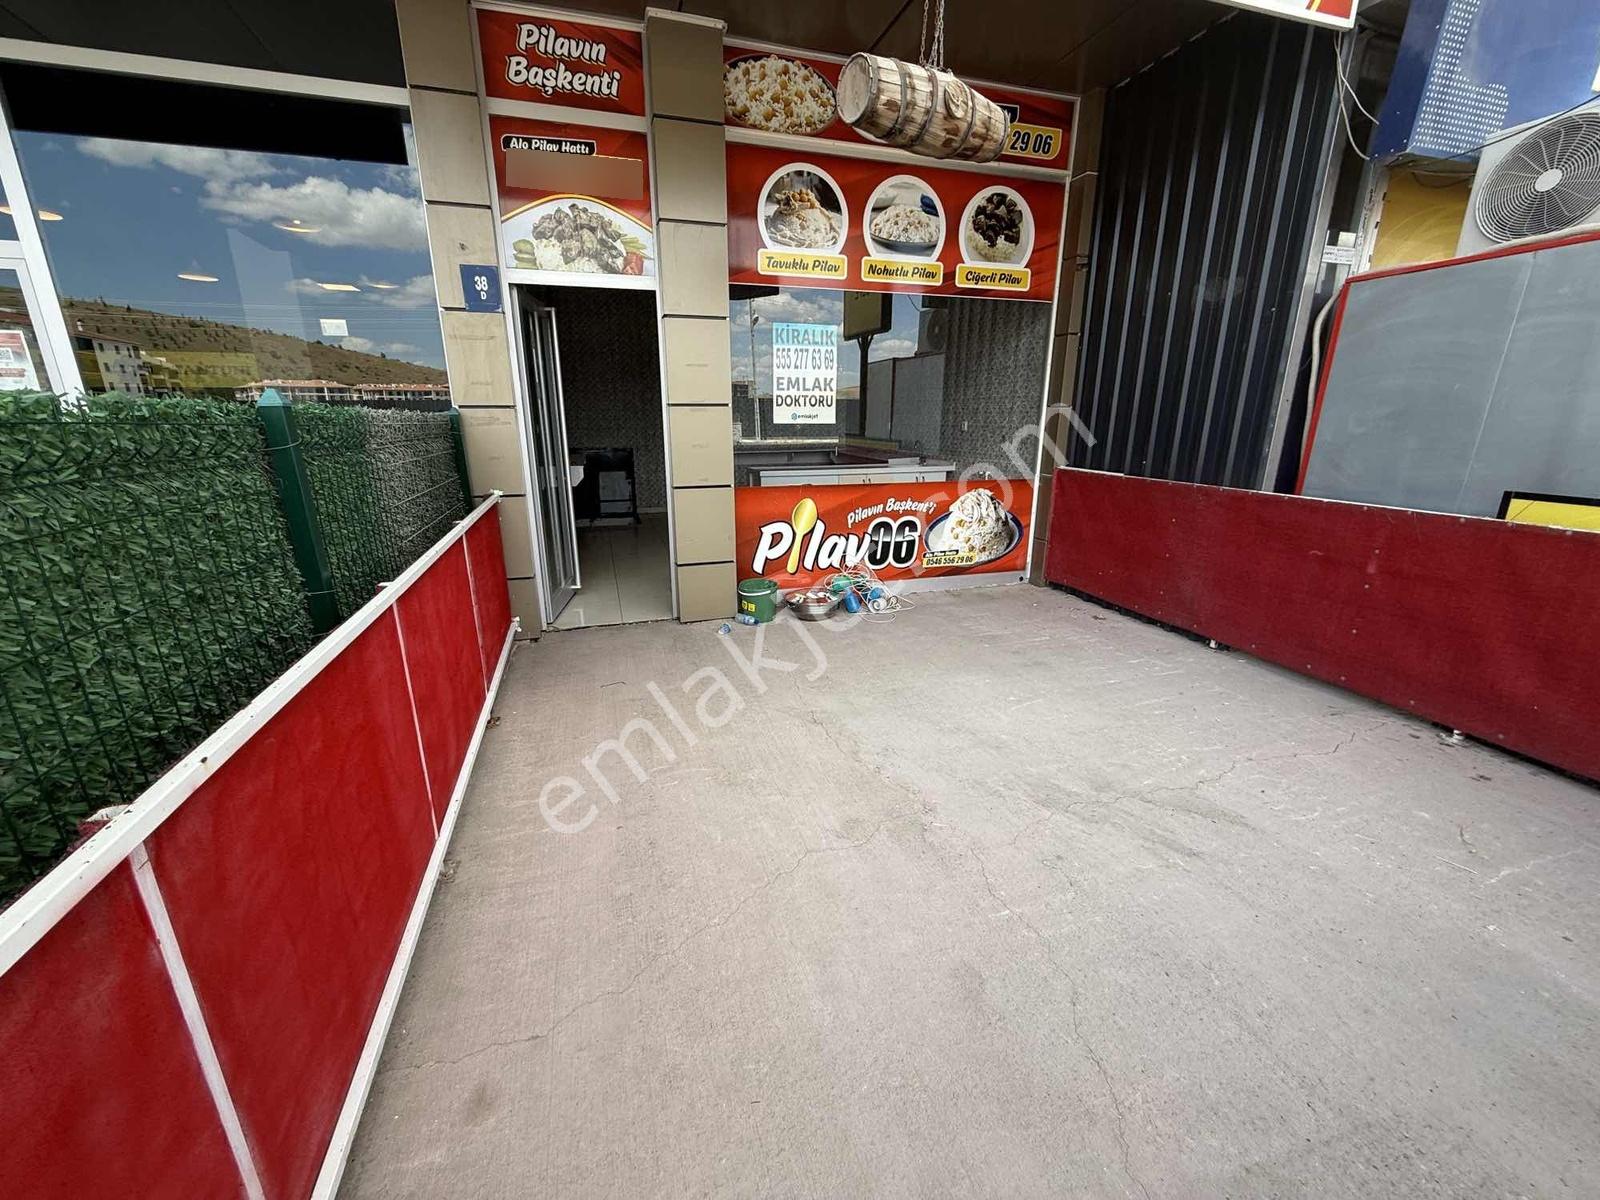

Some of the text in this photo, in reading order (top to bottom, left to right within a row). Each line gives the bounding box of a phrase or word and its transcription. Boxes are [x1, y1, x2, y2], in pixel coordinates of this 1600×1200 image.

[517, 23, 606, 65] Pilavın
[505, 55, 621, 99] Başkenti
[509, 137, 589, 154] Alo Pilav Hattı
[1010, 130, 1053, 155] 29 06
[765, 256, 841, 274] Tavuklu Pilav
[867, 263, 938, 280] Nohutlu Pilav
[474, 275, 488, 291] 38
[965, 270, 1023, 285] Ciğerli Pilav
[480, 290, 487, 300] D
[775, 324, 835, 347] KİRALIK
[775, 347, 834, 371] 555 277 63 69
[775, 376, 834, 393] EMLAK
[775, 394, 833, 408] DOKTORU
[847, 503, 884, 528] Pilavın
